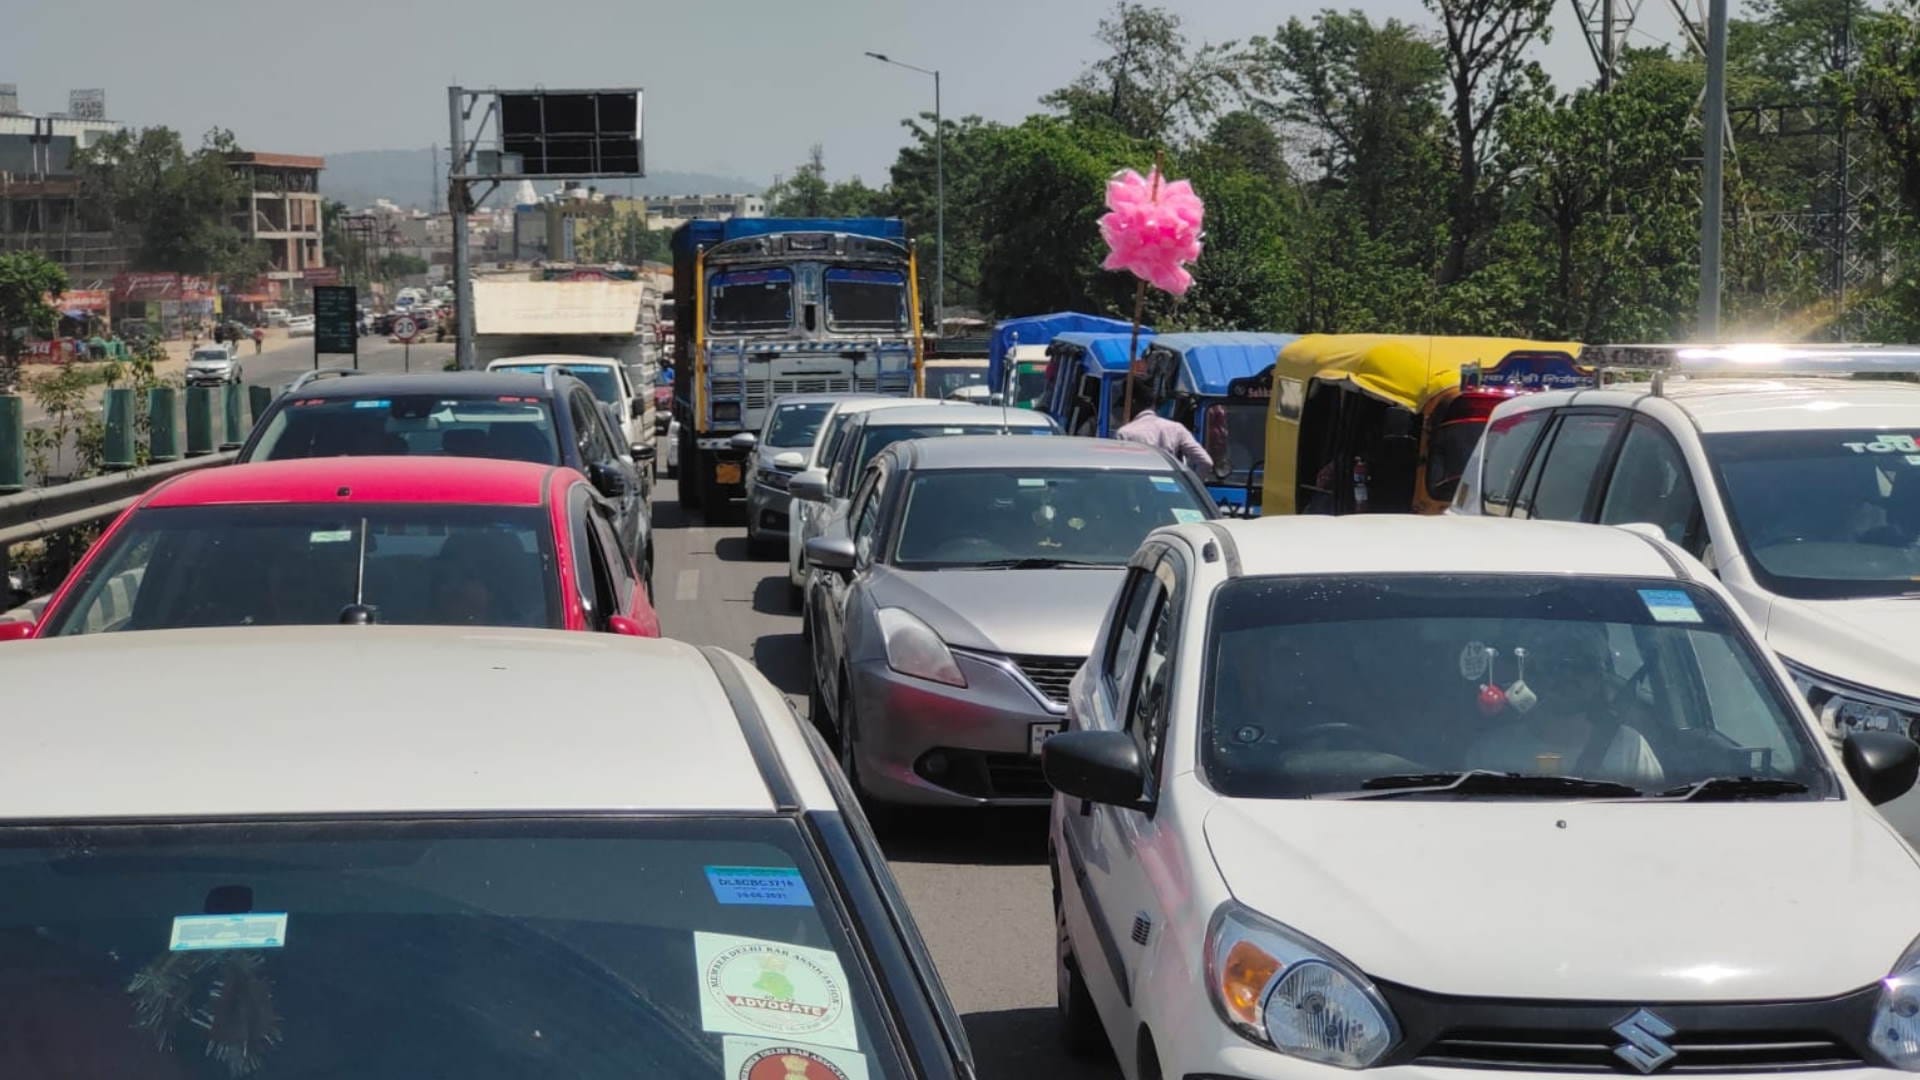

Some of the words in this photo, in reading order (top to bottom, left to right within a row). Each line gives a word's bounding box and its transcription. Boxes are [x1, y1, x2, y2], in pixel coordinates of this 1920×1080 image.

[729, 945, 763, 959] DELHI
[766, 946, 789, 957] BAR
[734, 997, 823, 1015] ADVOCATE
